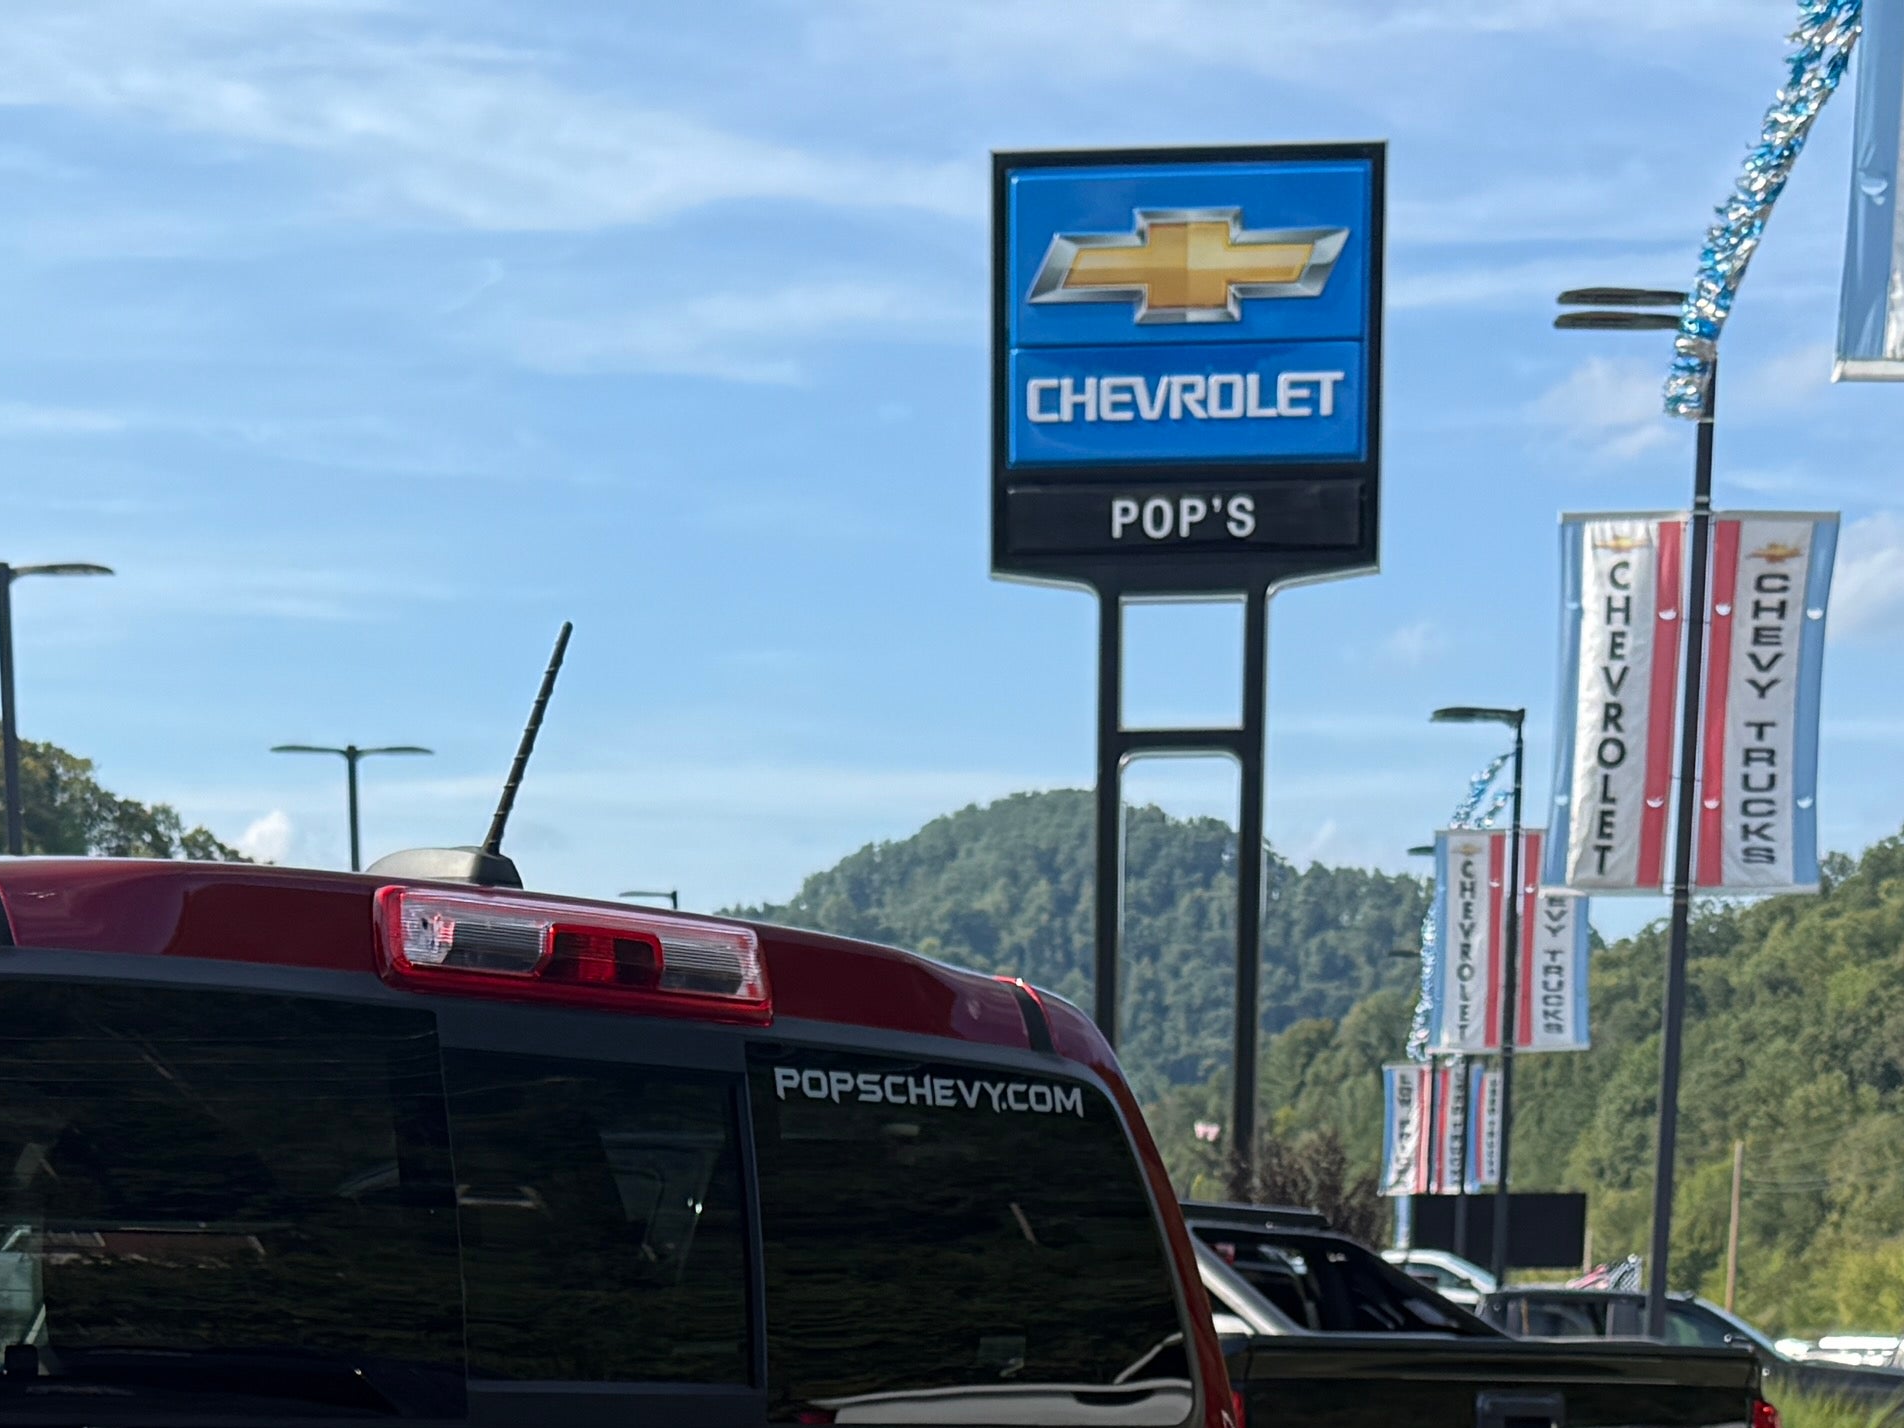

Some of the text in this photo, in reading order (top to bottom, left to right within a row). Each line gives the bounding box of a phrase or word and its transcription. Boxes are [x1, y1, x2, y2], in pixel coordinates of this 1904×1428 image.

[1026, 371, 1345, 424] CHEVROLET
[1111, 496, 1257, 539] POP'S
[1593, 560, 1632, 875] CHEVROLET
[1739, 572, 1792, 866] CHEVY TRUCKS
[774, 1065, 1084, 1119] POPSCHEVY.COM
